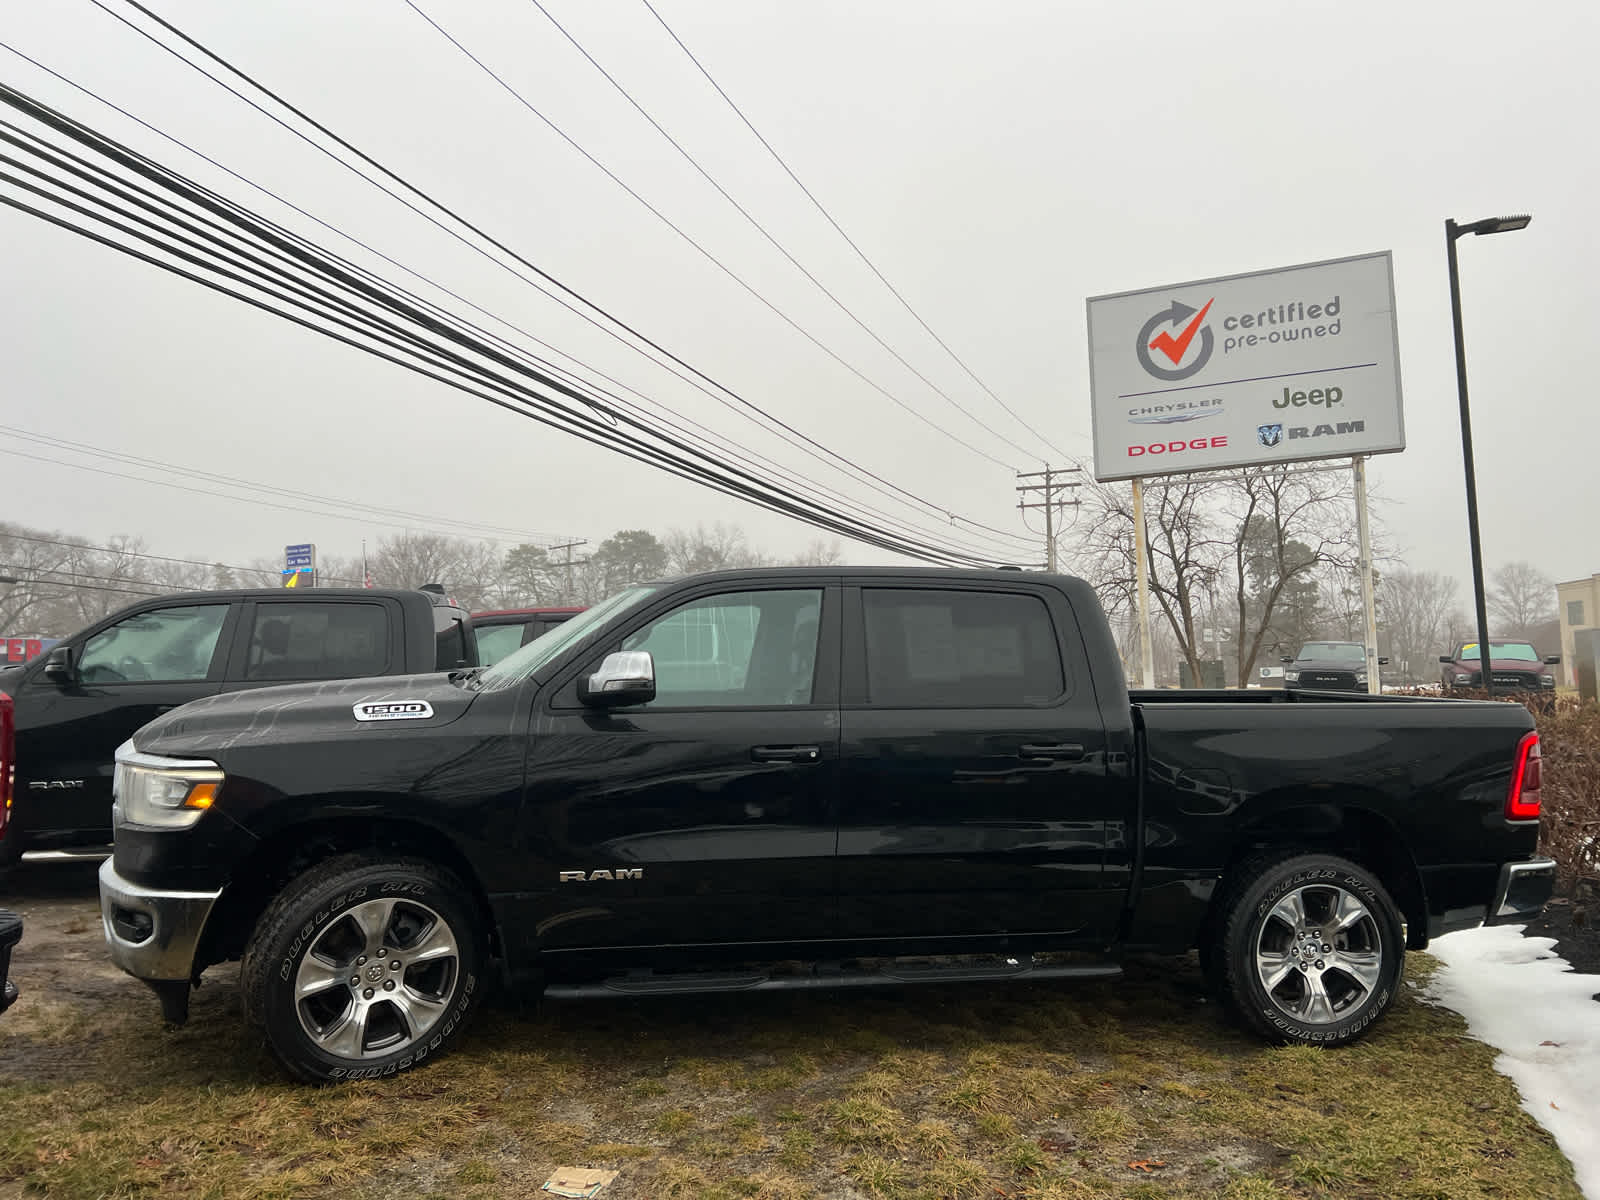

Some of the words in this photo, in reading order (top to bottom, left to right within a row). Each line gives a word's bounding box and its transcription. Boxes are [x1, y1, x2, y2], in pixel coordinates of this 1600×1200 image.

[1223, 296, 1340, 331] certified
[1224, 319, 1341, 353] pre-owned
[1128, 399, 1223, 416] CHRYSLER
[1272, 386, 1343, 409] Jeep
[1288, 420, 1365, 439] RAM
[1128, 436, 1228, 457] DODGE
[366, 704, 422, 714] 1500
[559, 868, 643, 882] RAM
